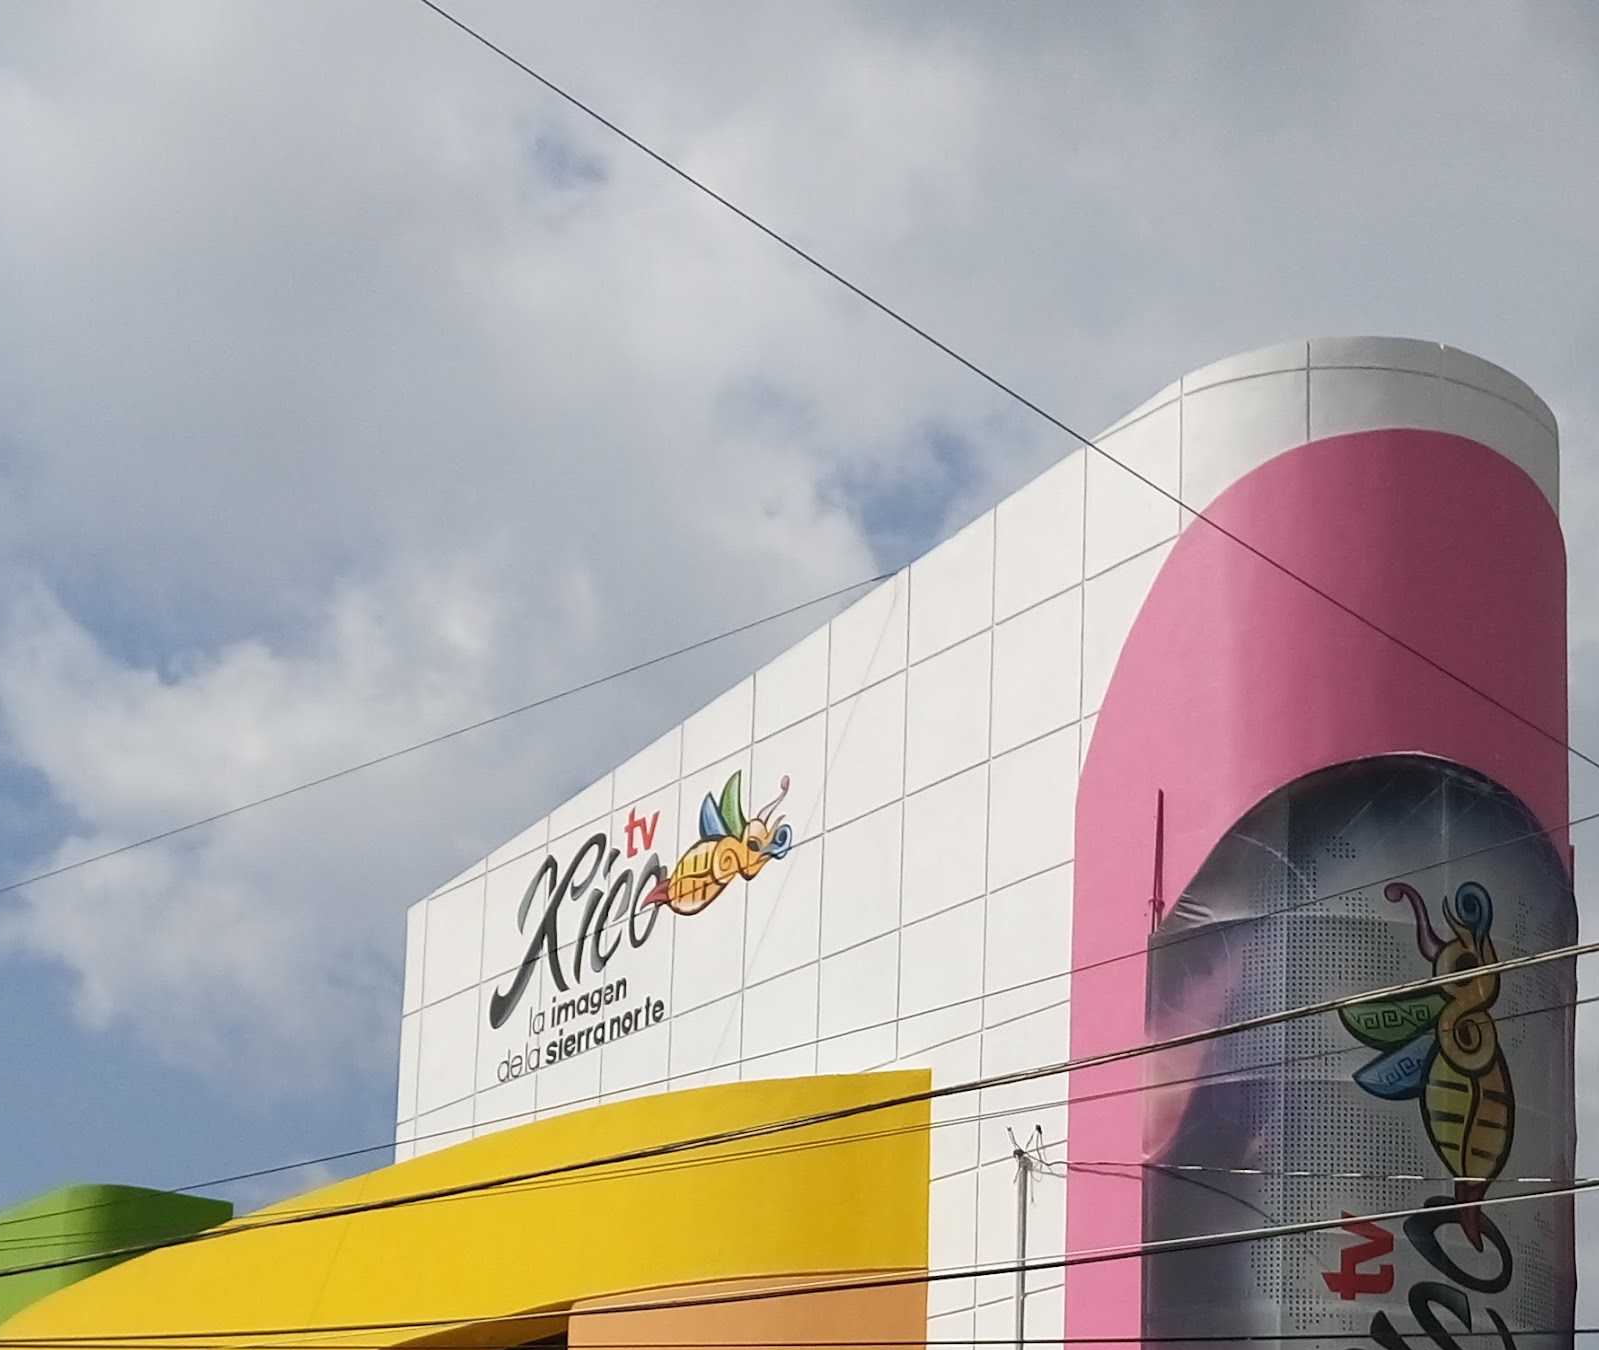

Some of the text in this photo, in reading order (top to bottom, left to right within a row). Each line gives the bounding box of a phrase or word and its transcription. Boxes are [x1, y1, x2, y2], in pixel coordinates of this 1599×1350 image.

[624, 807, 661, 858] tv
[490, 833, 667, 1030] Xico
[497, 996, 665, 1082] de la sierra norte
[529, 977, 627, 1037] la imagen
[1321, 1209, 1395, 1301] tv
